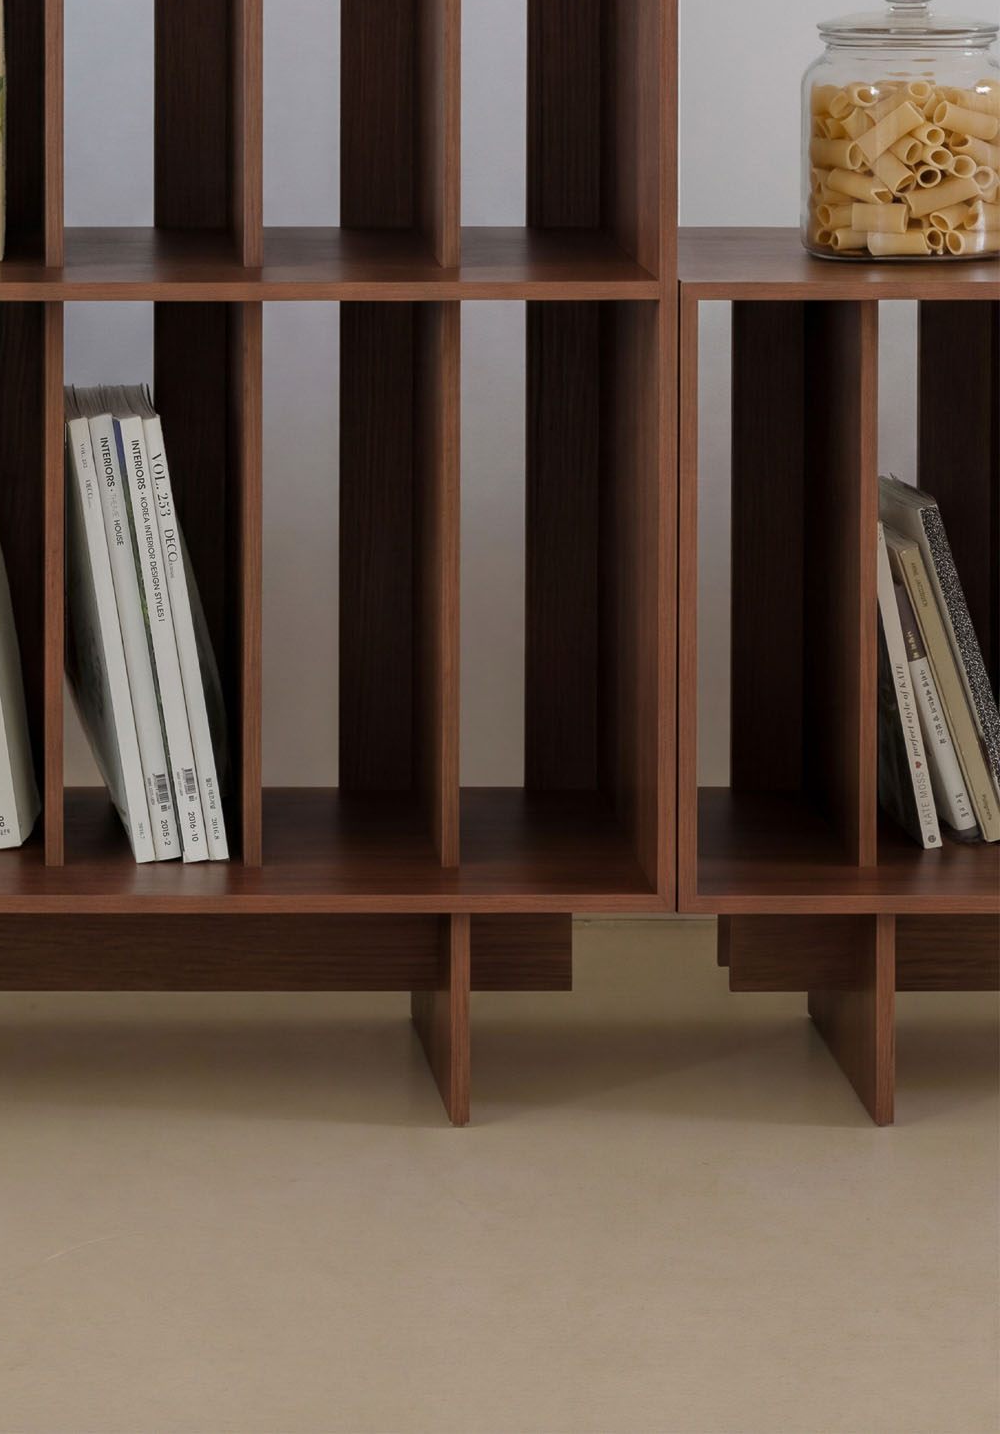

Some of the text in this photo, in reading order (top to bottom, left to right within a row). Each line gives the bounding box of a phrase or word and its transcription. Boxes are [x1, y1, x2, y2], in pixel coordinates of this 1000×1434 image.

[131, 439, 146, 490] INTERIORS
[152, 452, 166, 490] VOL.
[100, 437, 115, 487] INTERIORS
[114, 519, 124, 546] HOUSE
[157, 492, 171, 517] 253
[140, 496, 151, 523] KOREA
[144, 524, 156, 559] INTERIOR
[149, 561, 161, 590] DESIGN
[154, 592, 165, 618] STYLES
[900, 690, 909, 700] of
[903, 701, 913, 724] style
[907, 726, 921, 757] perfect
[915, 771, 933, 825] KATE MOSS
